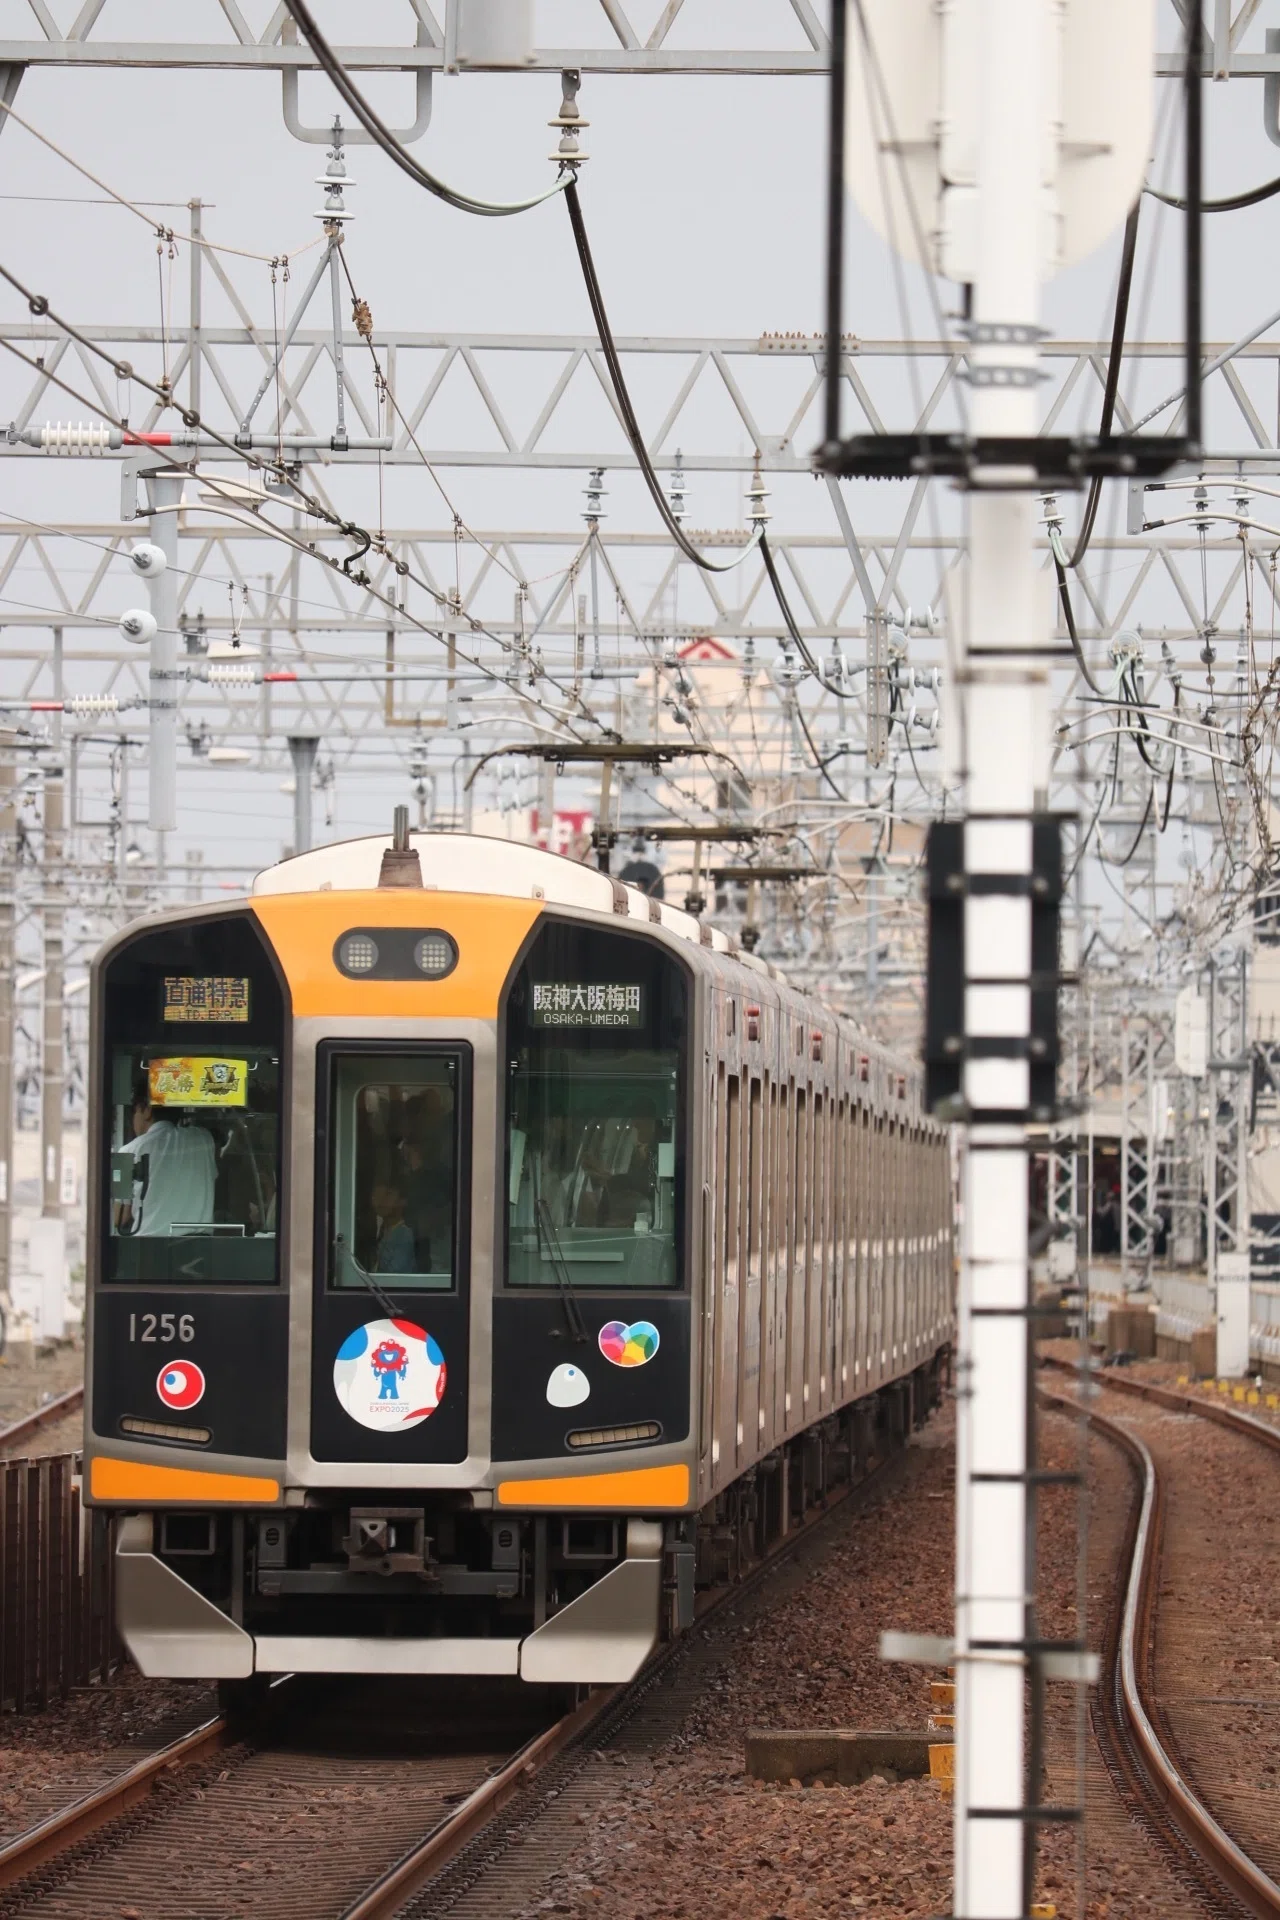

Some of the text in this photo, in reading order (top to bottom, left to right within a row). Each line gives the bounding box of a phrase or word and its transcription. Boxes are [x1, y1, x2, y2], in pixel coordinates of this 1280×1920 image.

[165, 977, 247, 1008] 直通特急
[533, 984, 640, 1012] 阪神大阪梅田
[543, 1013, 630, 1025] OSAKA-UMEDA
[129, 1313, 195, 1342] 1256
